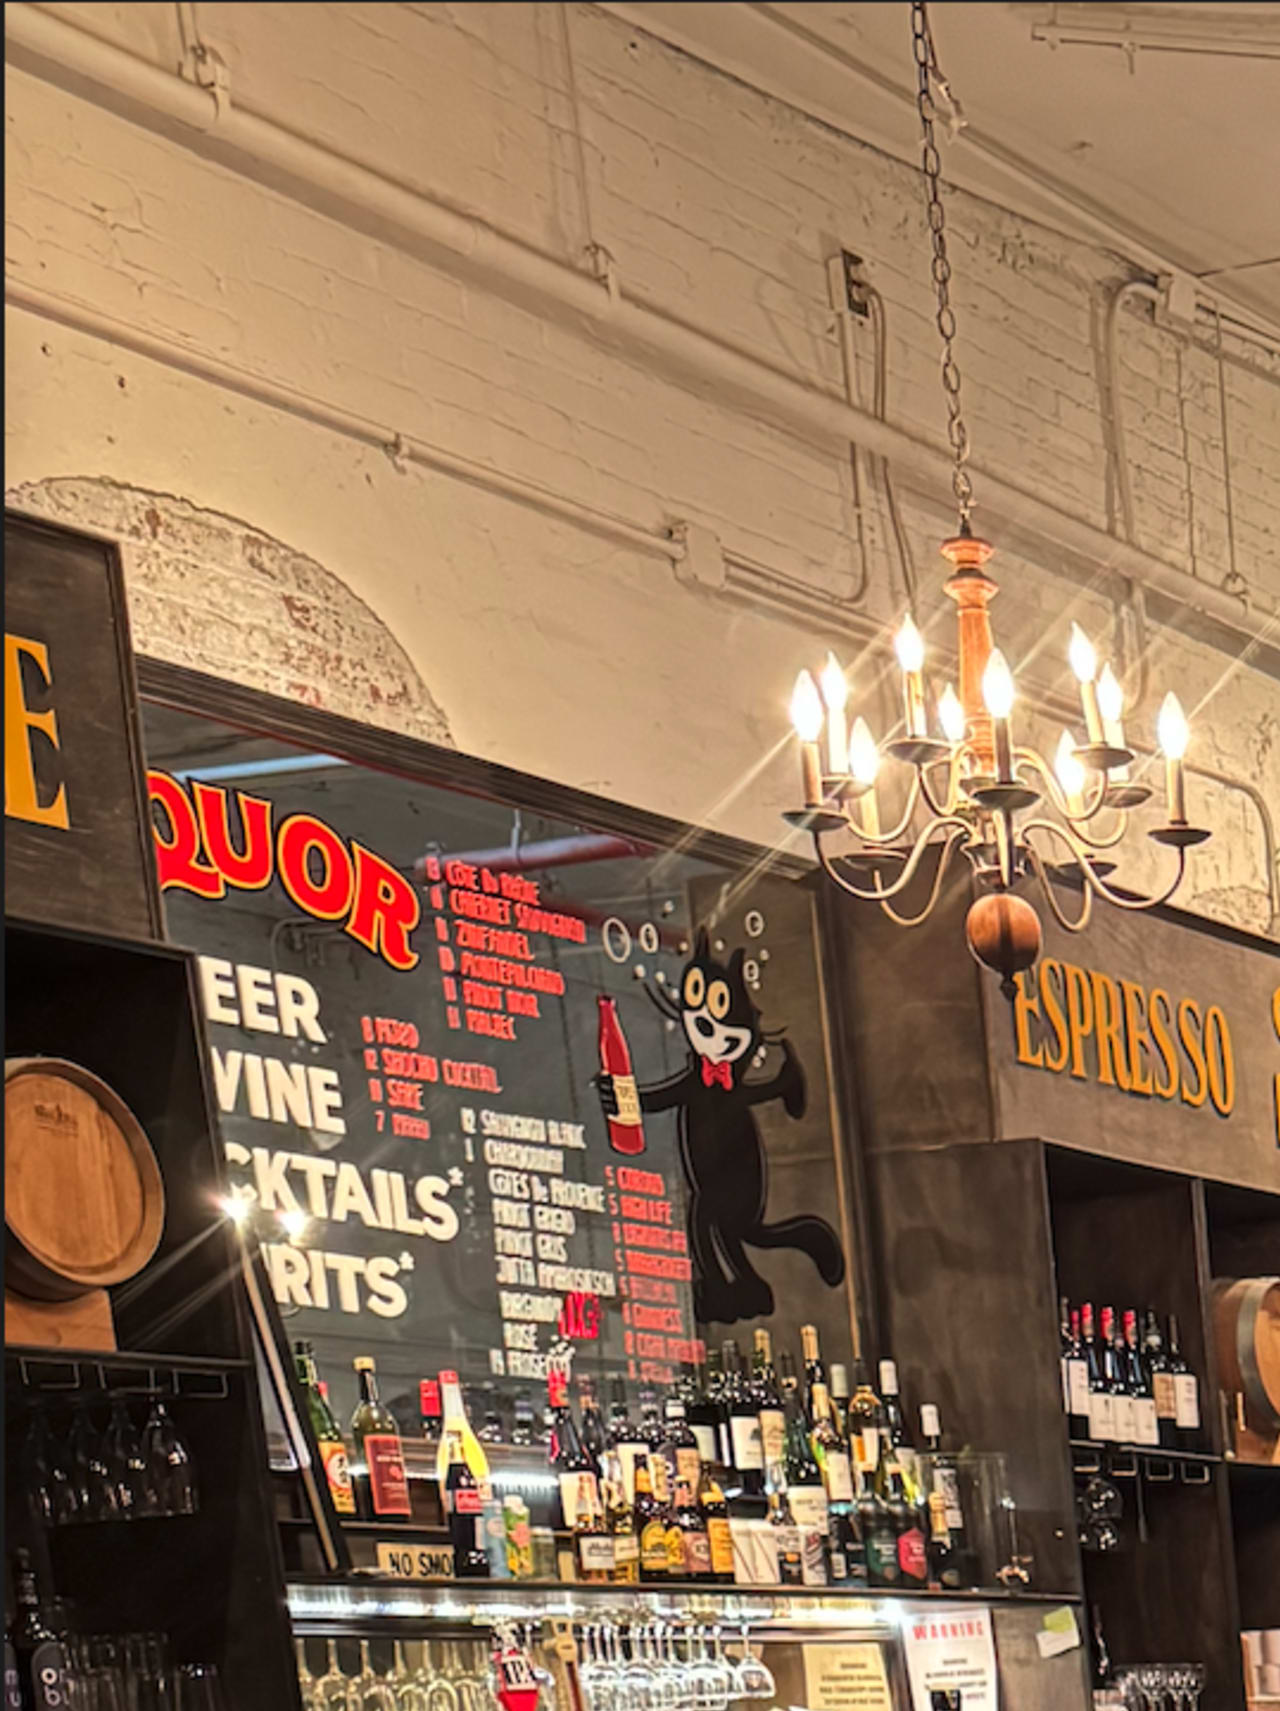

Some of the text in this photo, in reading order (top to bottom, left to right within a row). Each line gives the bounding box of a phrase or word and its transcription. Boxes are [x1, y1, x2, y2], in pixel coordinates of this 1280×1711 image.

[145, 768, 420, 972] QUOR
[198, 954, 327, 1045] EER
[1014, 957, 1236, 1118] ESPRESSO
[388, 1551, 453, 1577] NO SMO
[912, 1620, 984, 1641] WARNING
